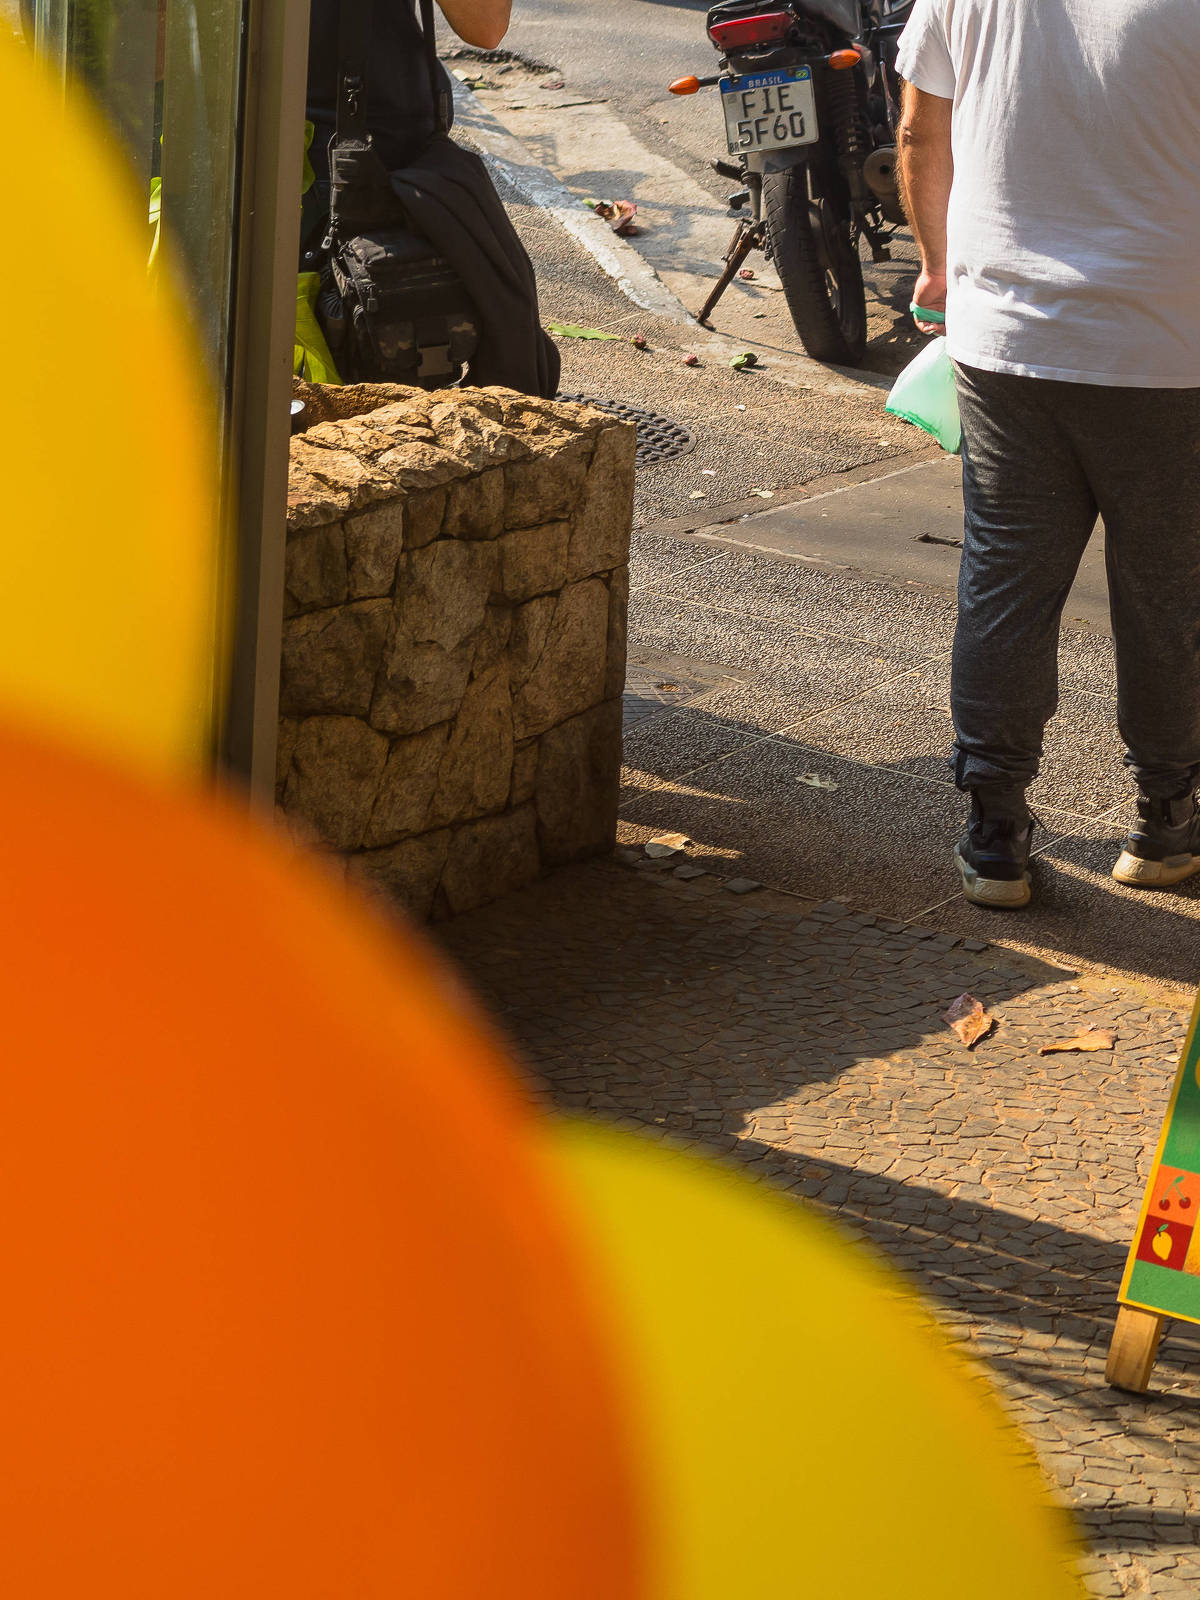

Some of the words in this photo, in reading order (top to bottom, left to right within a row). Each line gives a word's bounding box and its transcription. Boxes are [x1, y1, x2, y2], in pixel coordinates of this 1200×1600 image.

[748, 76, 782, 88] BRASIL
[742, 85, 794, 118] FIE
[737, 112, 805, 147] 5F60
